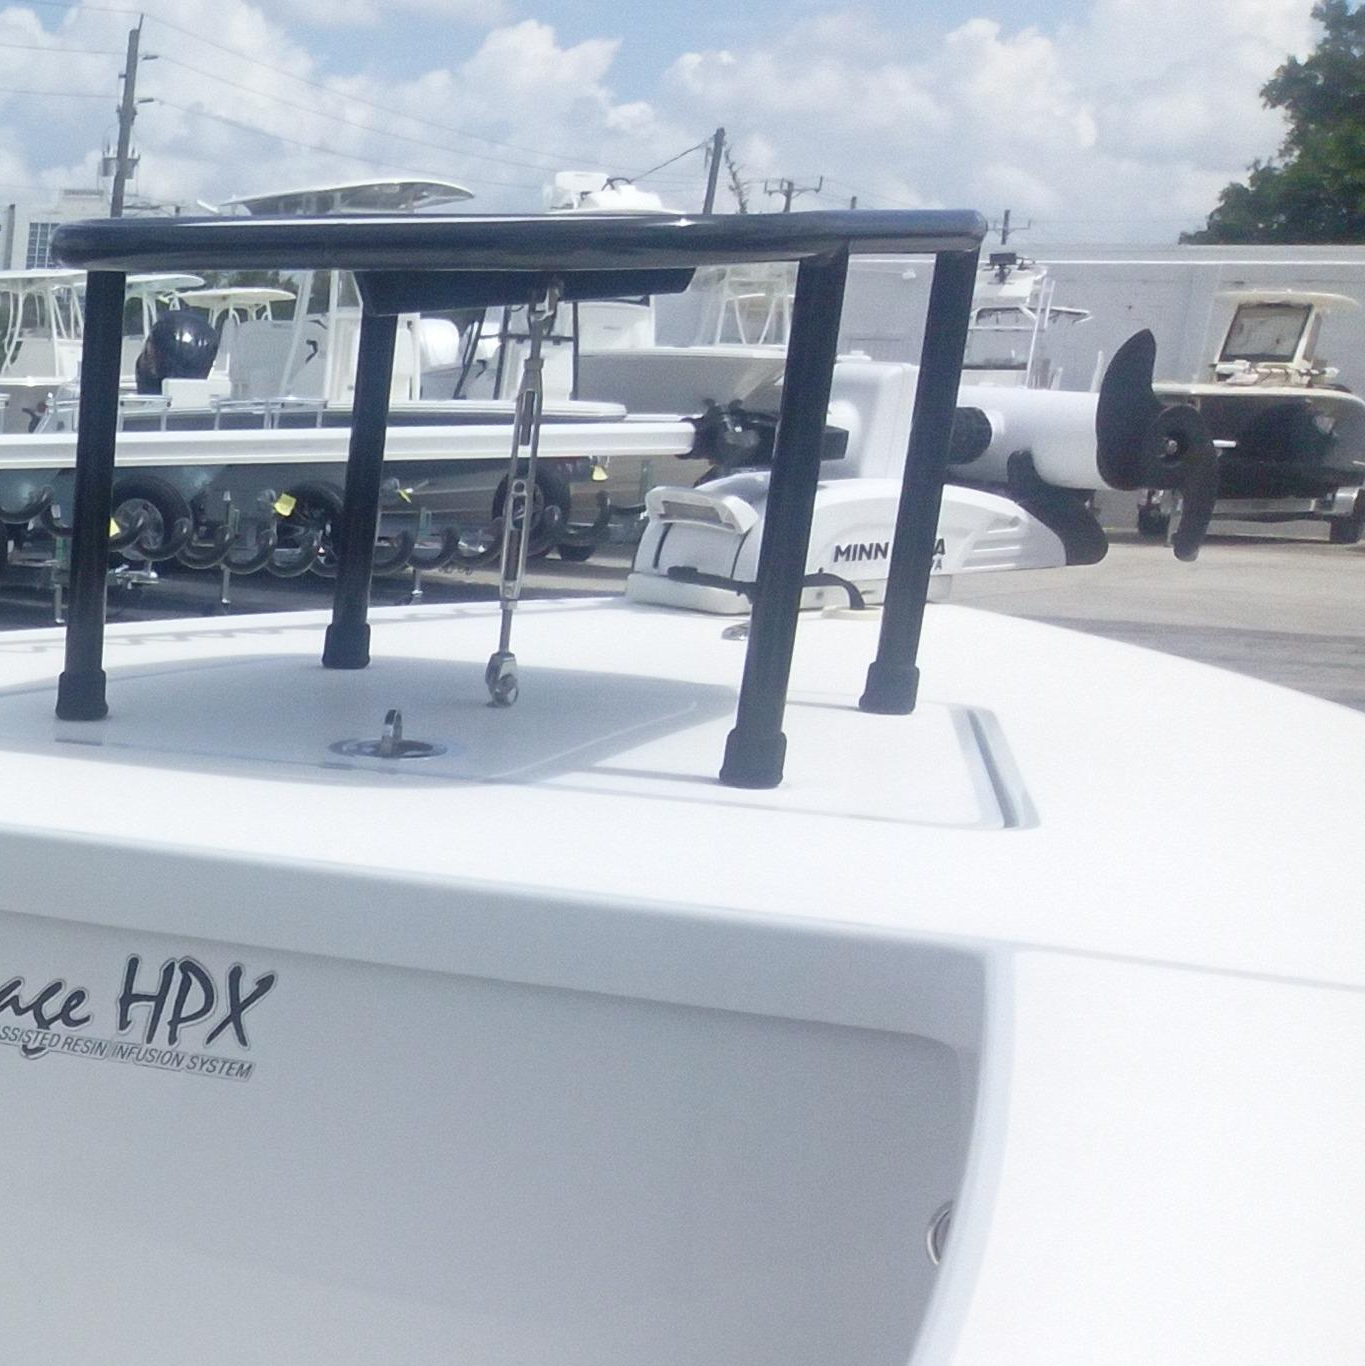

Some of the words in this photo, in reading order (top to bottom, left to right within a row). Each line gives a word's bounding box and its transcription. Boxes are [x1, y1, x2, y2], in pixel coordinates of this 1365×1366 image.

[833, 541, 890, 563] MINN
[118, 956, 276, 1047] HPX
[61, 1036, 108, 1057] RESIN
[110, 1043, 185, 1068] INFUSION
[185, 1055, 253, 1079] SYSTEM
